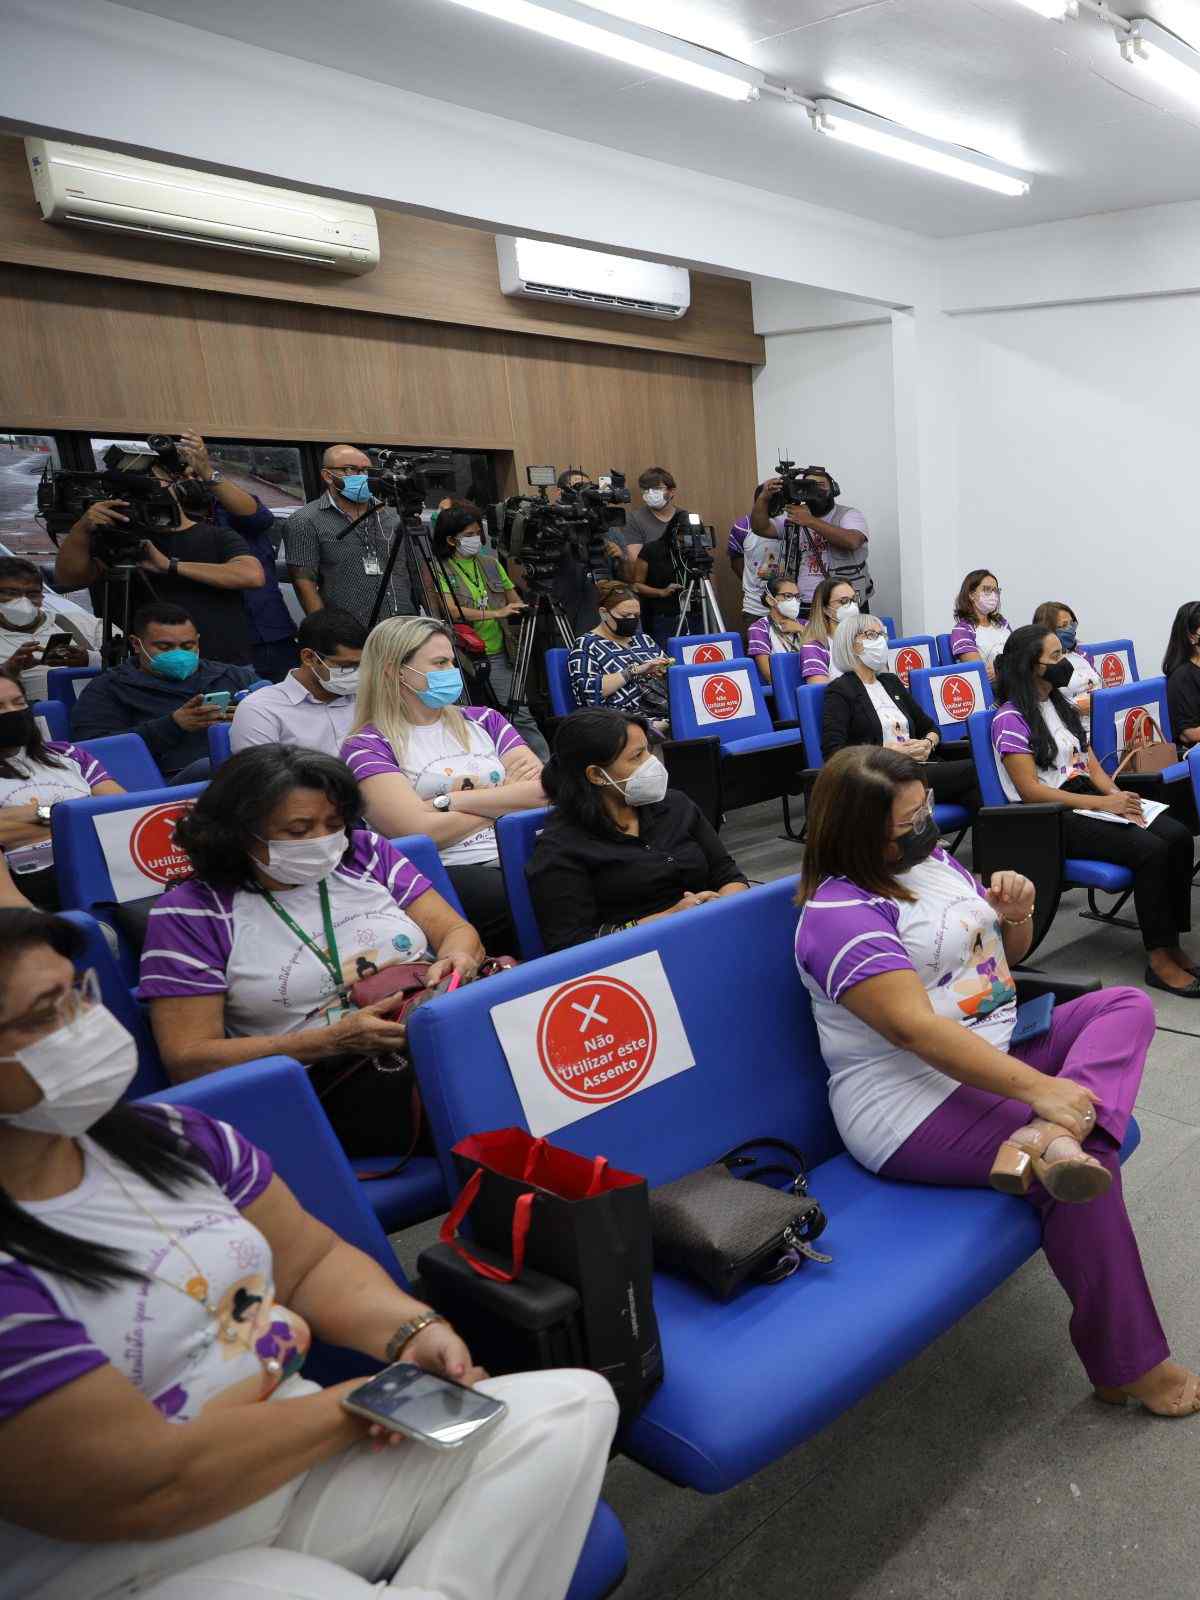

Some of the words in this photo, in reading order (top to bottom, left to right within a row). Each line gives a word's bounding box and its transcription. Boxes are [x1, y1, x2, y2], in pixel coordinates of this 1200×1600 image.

[147, 855, 191, 869] Utiliza
[165, 865, 194, 877] Asse
[583, 1033, 615, 1053] Não
[560, 1050, 614, 1081] Utilizar
[617, 1037, 648, 1057] este
[582, 1059, 639, 1090] Assento
